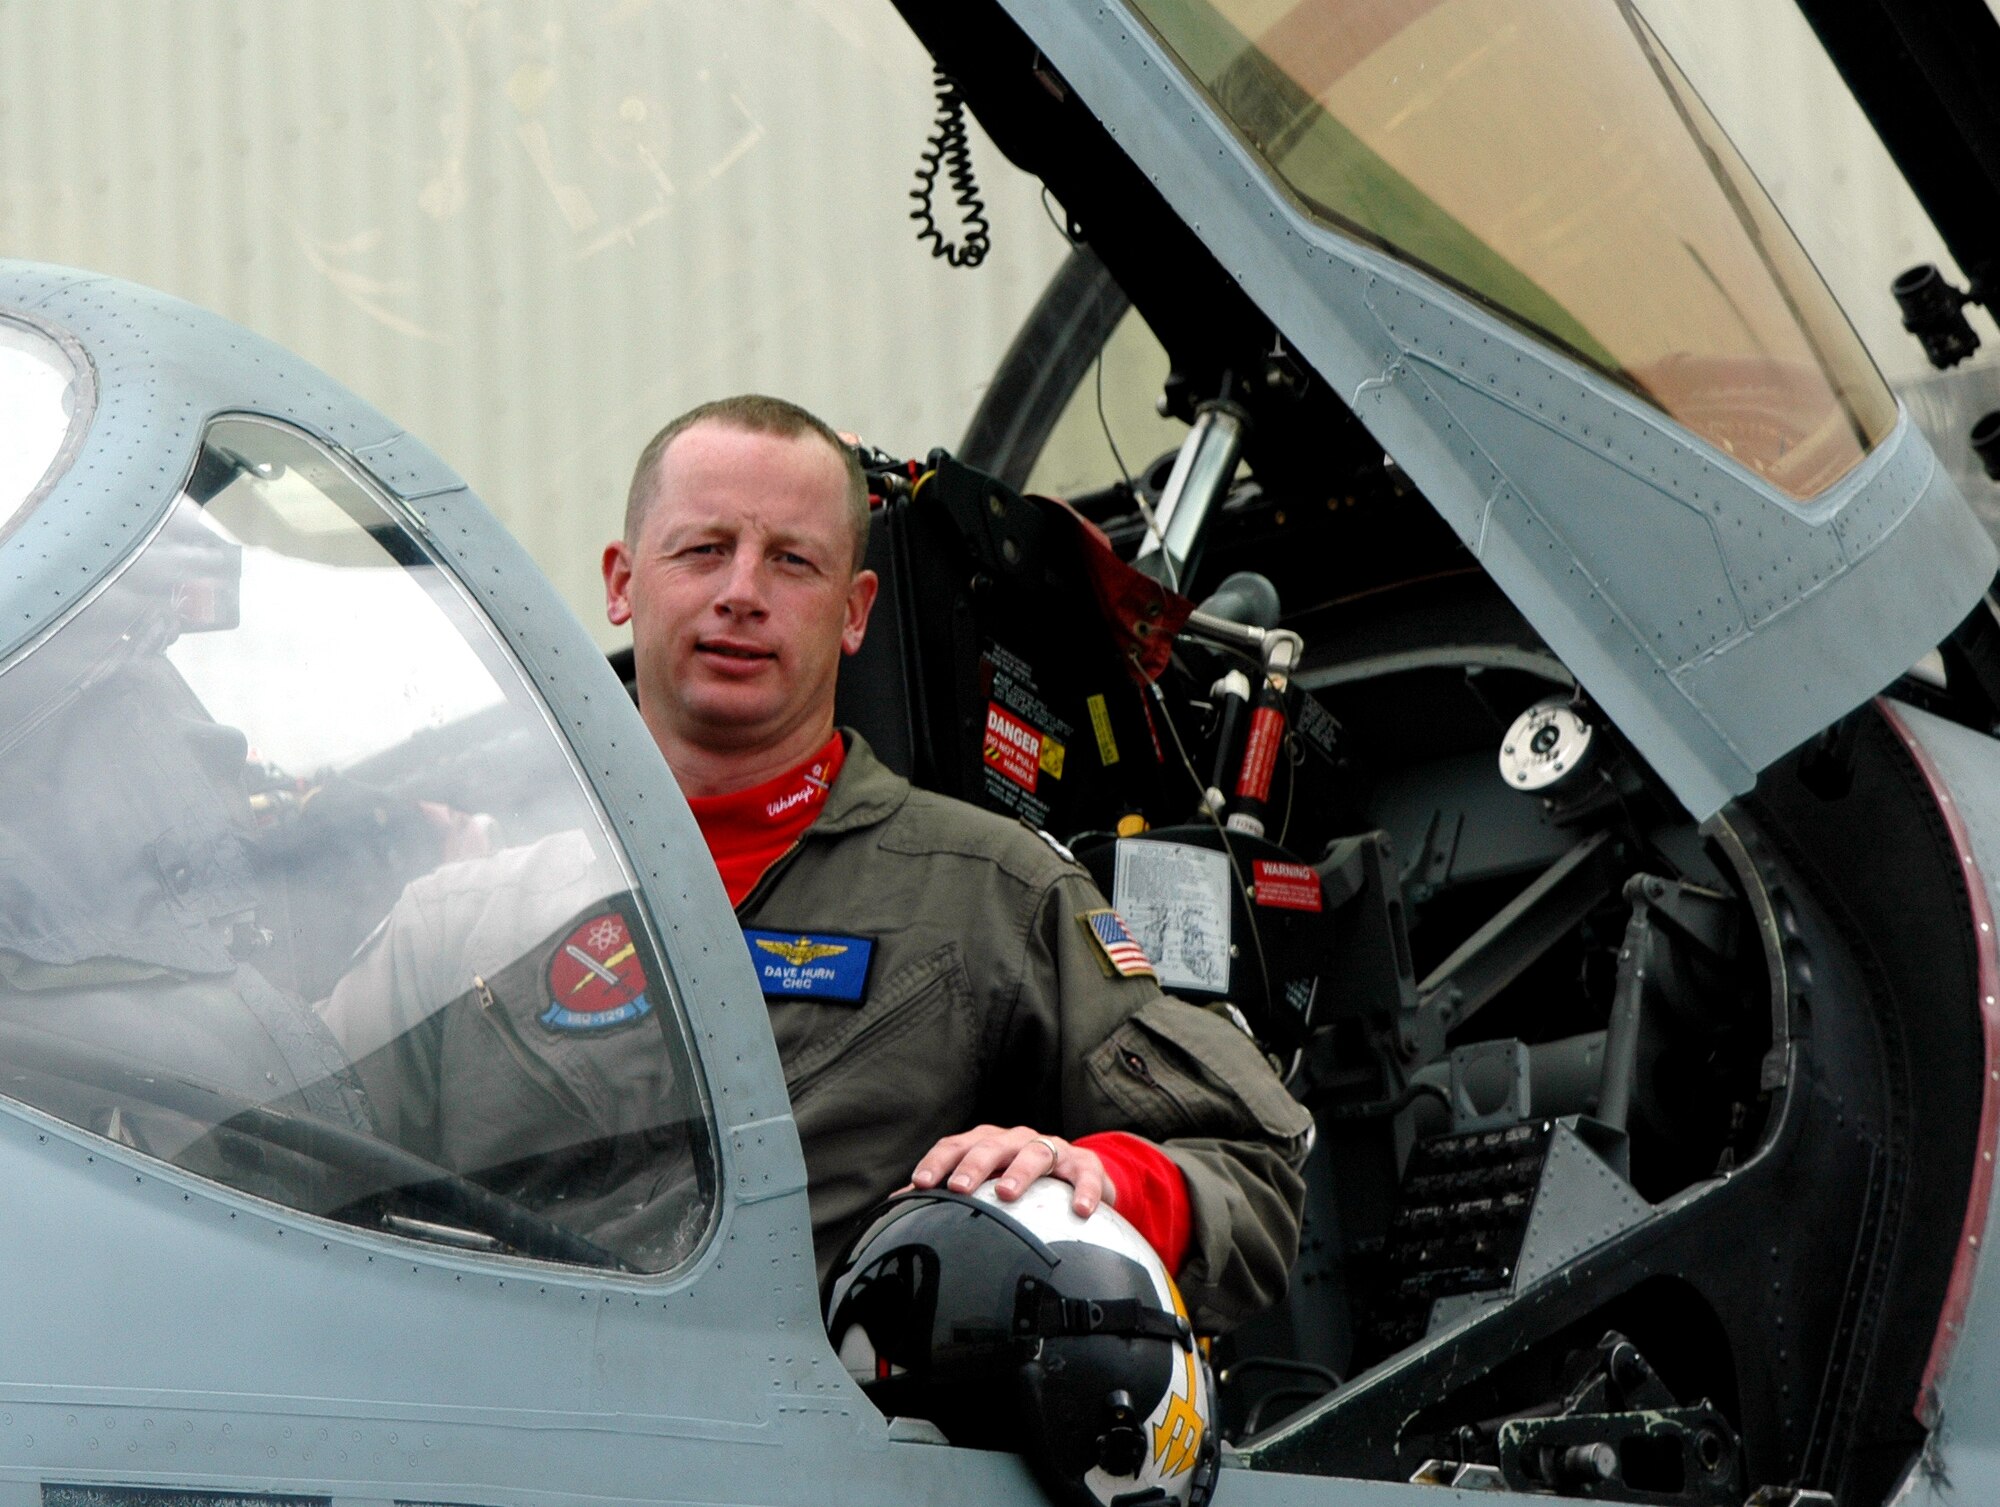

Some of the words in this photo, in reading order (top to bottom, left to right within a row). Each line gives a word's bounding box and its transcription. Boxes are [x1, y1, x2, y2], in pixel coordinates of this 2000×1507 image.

[988, 710, 1039, 758] DANGER
[986, 732, 998, 748] DO
[998, 741, 1015, 758] NOT
[1016, 752, 1035, 772] PULL
[1003, 758, 1035, 785] HANDLE
[1262, 861, 1310, 880] WARNING
[764, 965, 797, 978] DAVE
